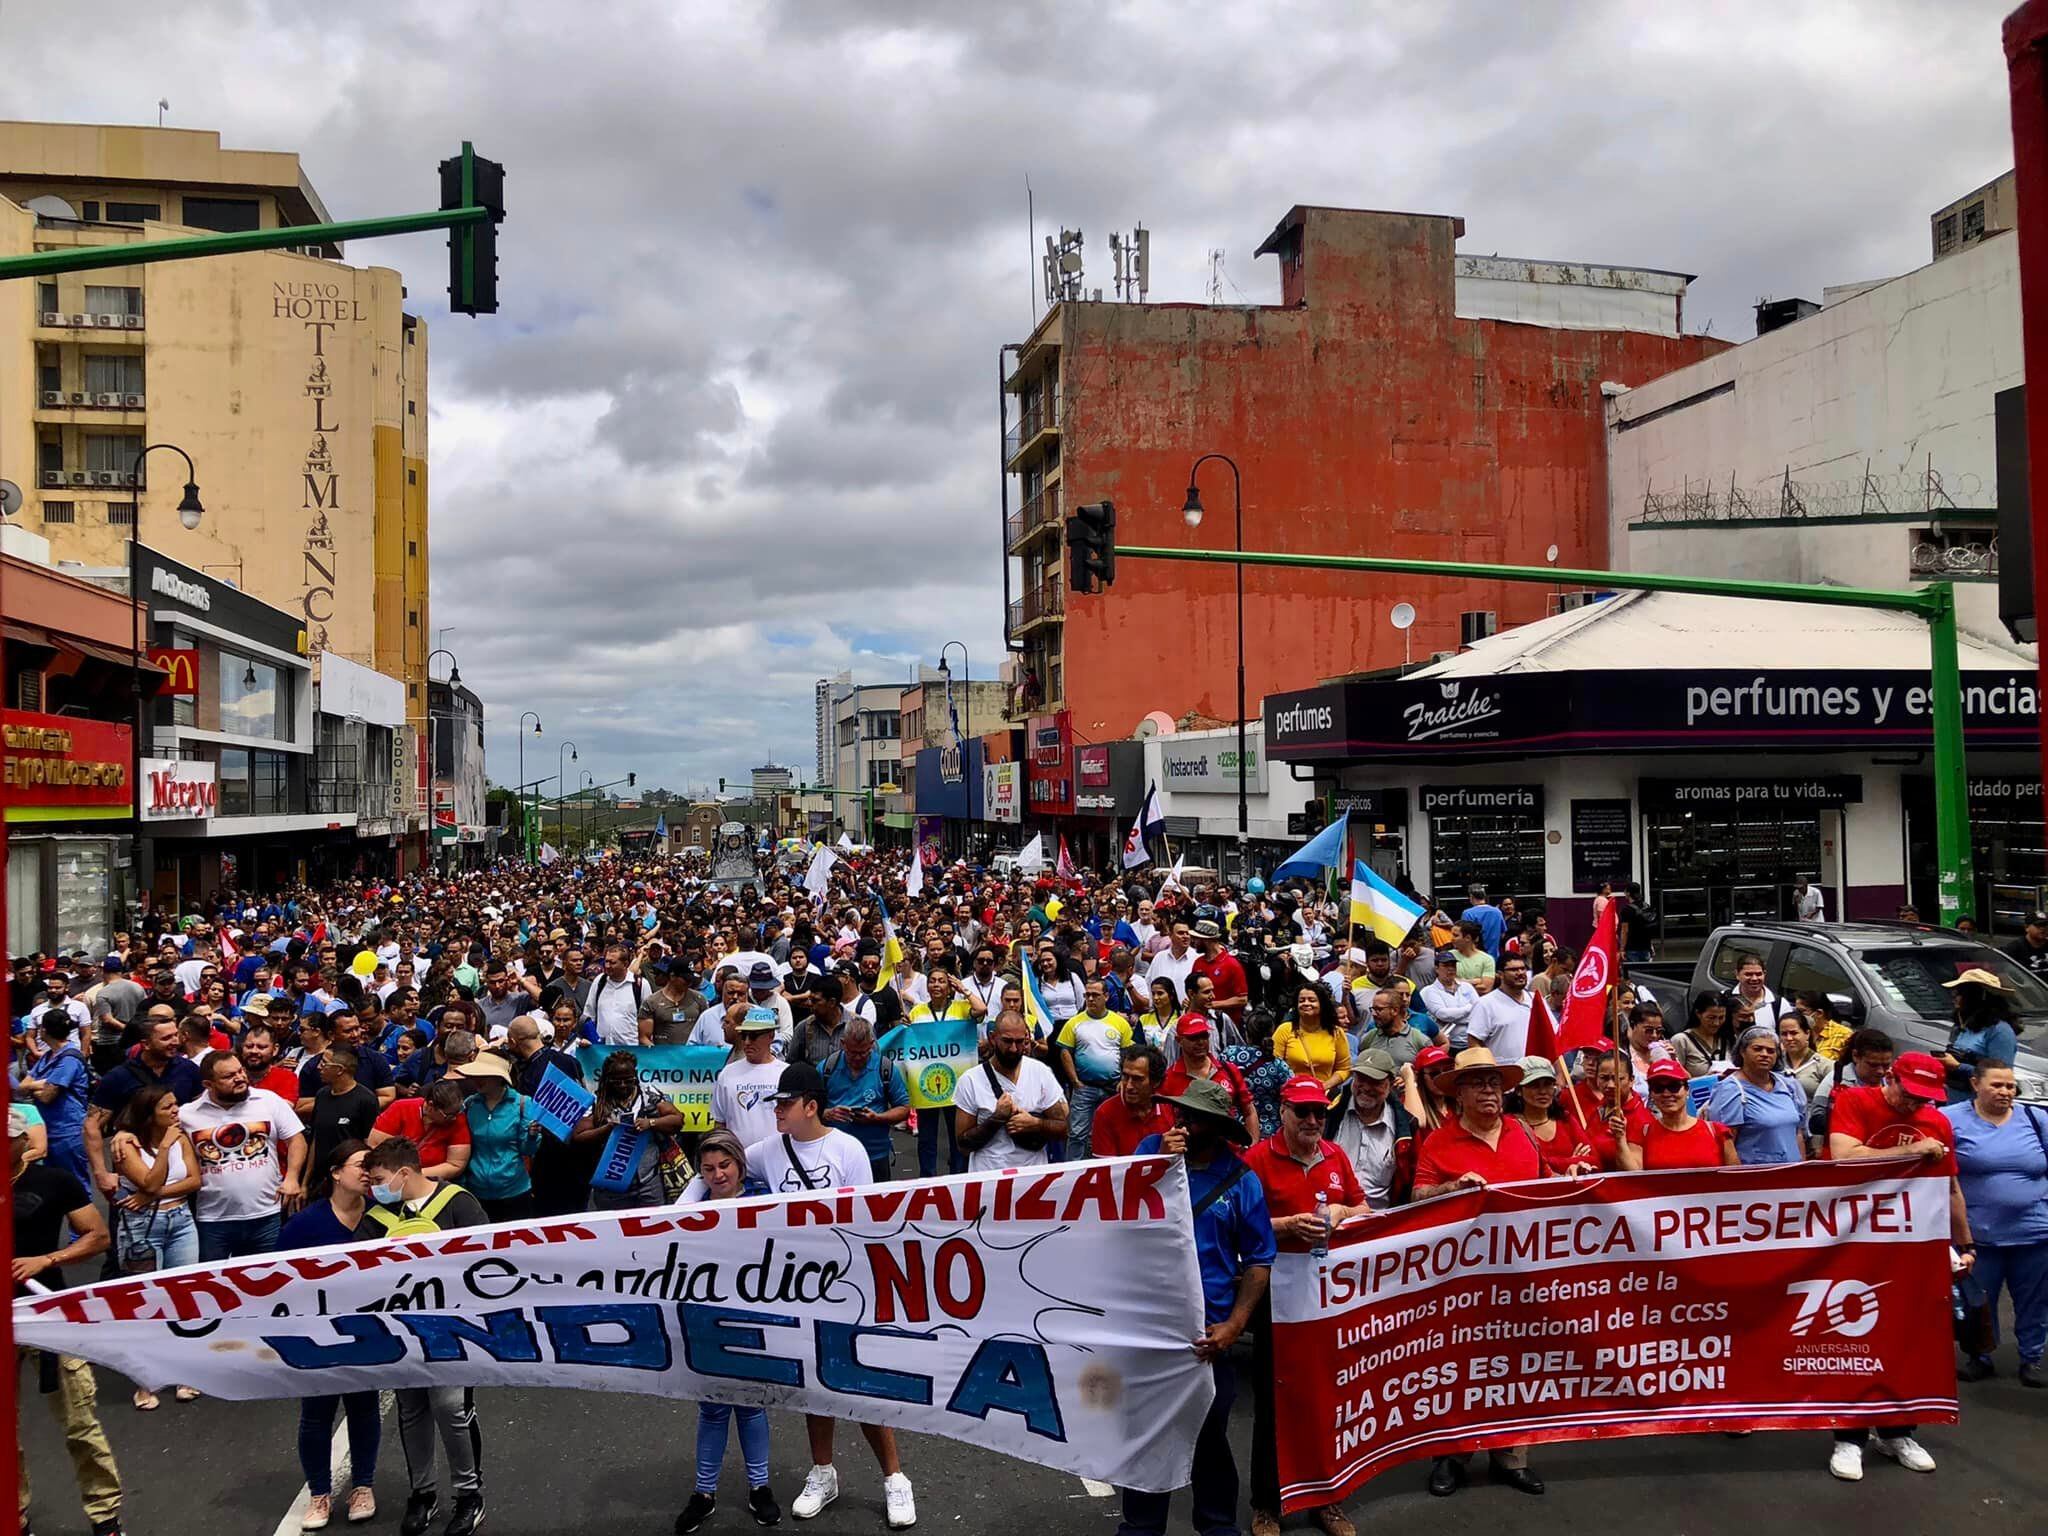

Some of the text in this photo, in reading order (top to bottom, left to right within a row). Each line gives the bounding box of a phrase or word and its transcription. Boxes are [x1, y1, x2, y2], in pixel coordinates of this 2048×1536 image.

[273, 282, 339, 298] NUEVO
[273, 298, 367, 321] HOTEL
[151, 567, 210, 611] McDonald's
[1276, 702, 1333, 740] perfumes
[1403, 688, 1492, 737] Fraiche
[1686, 677, 2042, 726] perfumes y esncia
[393, 726, 403, 768] TODO
[1169, 755, 1208, 777] Instacredit
[151, 771, 217, 816] Merayo
[1425, 788, 1534, 810] perfumería
[1674, 781, 1844, 802] aromas para tu vida...
[1968, 780, 2012, 797] idado
[909, 1042, 961, 1061] SALUD
[534, 1080, 587, 1129] UNDECA
[735, 1158, 1171, 1230] PRIVATIZAR
[1318, 1191, 1914, 1309] ¡SIPROCIMECA PRESENTE!
[736, 1238, 847, 1304] dice
[864, 1237, 986, 1323] NO
[1336, 1270, 1678, 1349] Luchamos por la defensa de la
[1786, 1279, 1890, 1336] 70
[1336, 1301, 1729, 1386] autonomía institucional de la CCSS
[1783, 1357, 1884, 1372] SIPROCIMECA
[1795, 1343, 1871, 1354] ANIVERSARIO
[260, 1302, 1068, 1443] UNDECA
[1335, 1334, 1733, 1429] ¡LA CCSS ES DEL PUEBLO!
[1335, 1363, 1726, 1460] ¡NO A SU PRIVATIZACIÓN!
